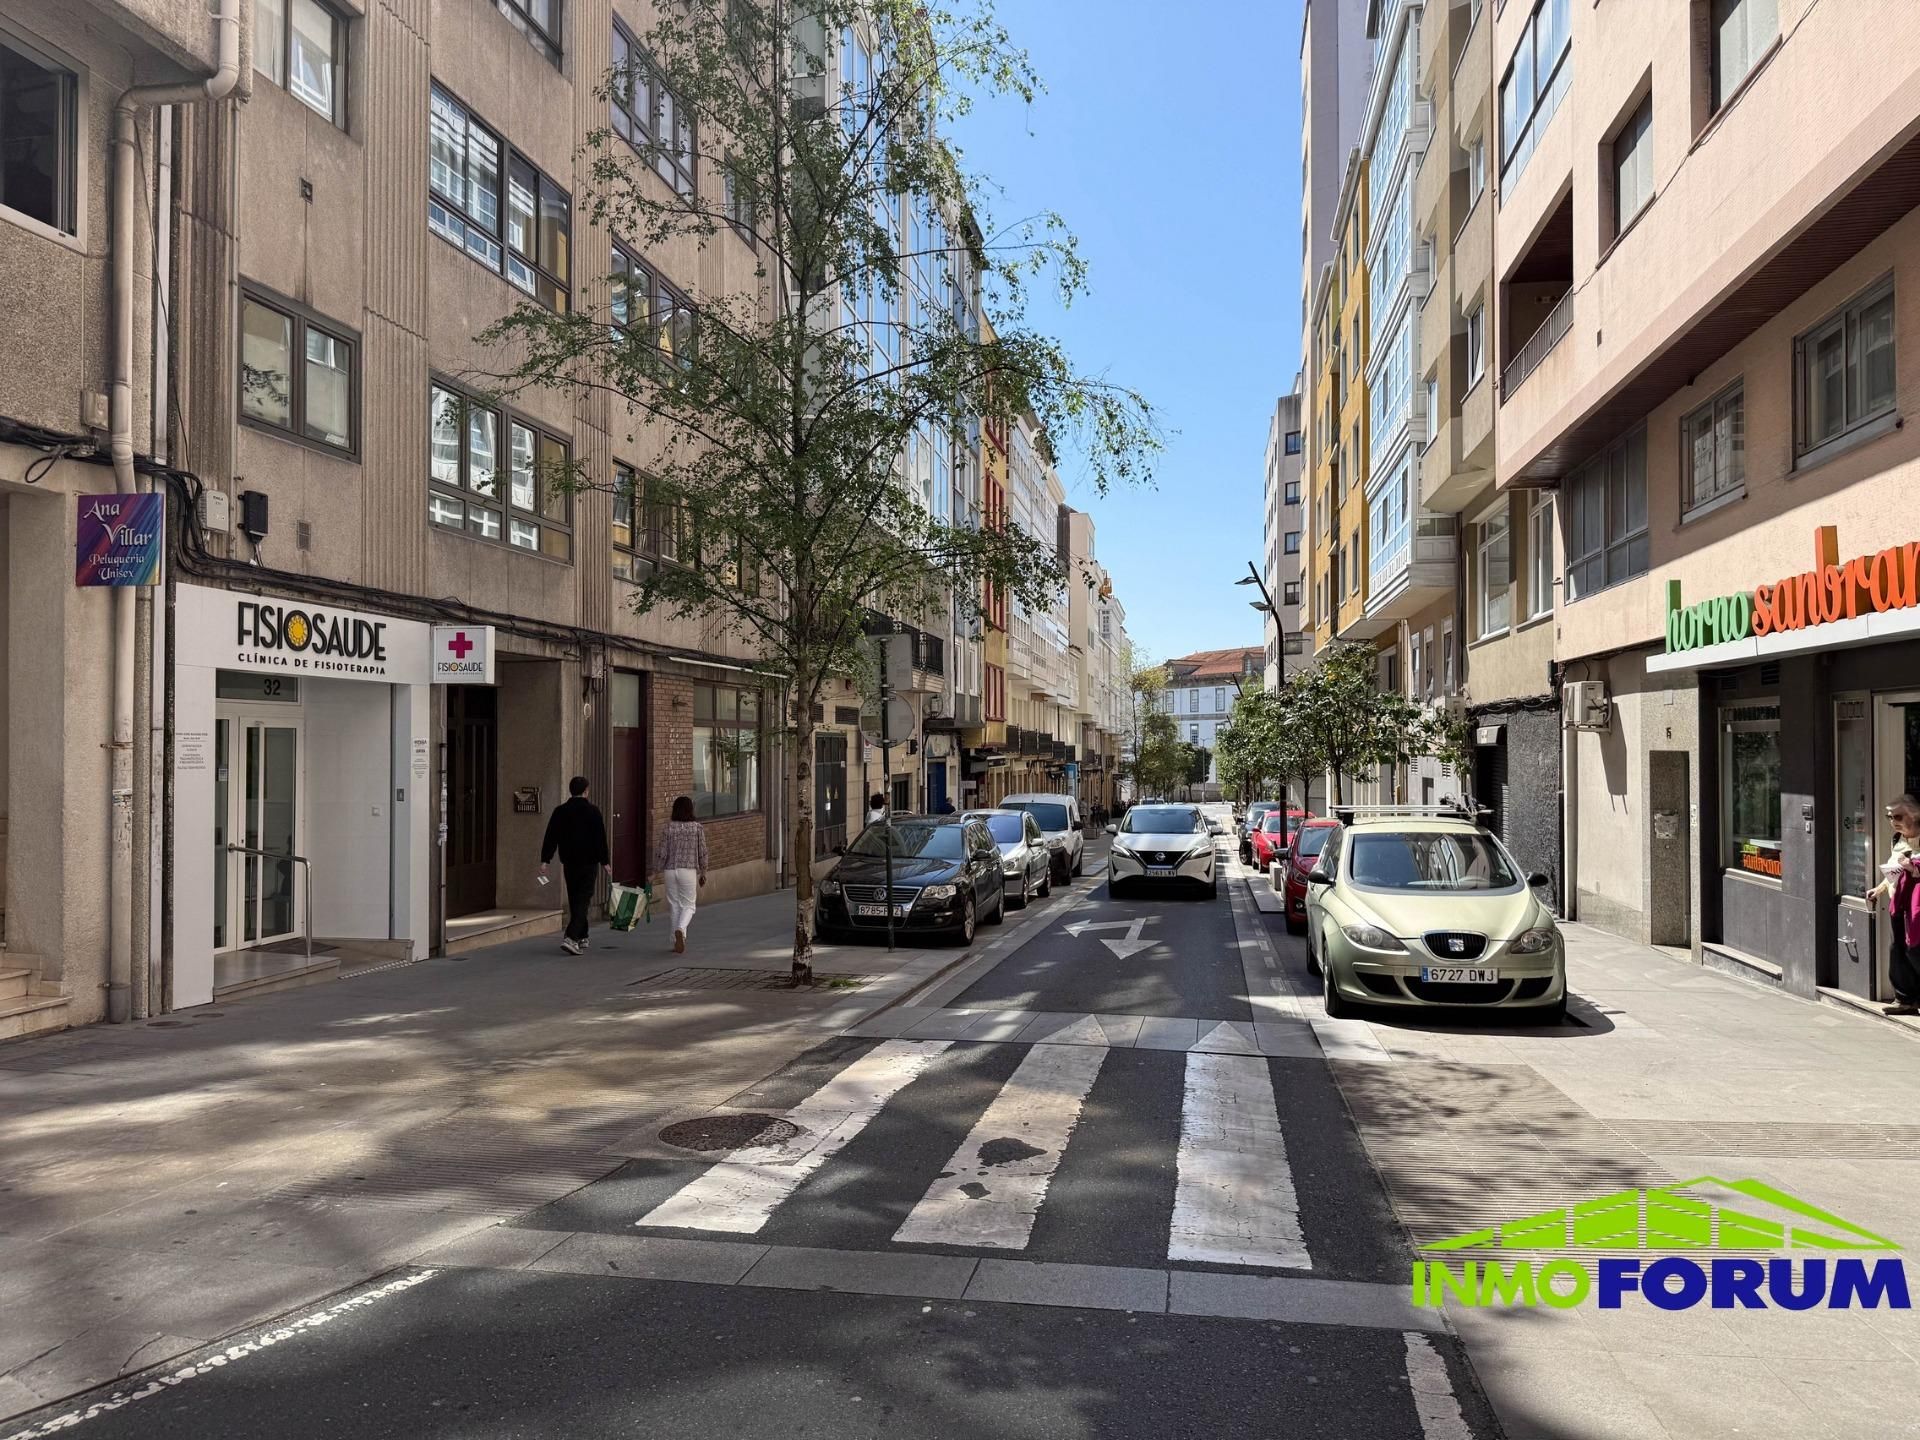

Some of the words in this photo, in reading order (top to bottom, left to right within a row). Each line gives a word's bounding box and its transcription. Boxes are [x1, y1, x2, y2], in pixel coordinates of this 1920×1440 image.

[83, 500, 120, 522] Ana
[101, 523, 152, 546] Villar
[98, 567, 135, 580] Unisex
[1665, 579, 1749, 655] horno
[238, 601, 387, 661] FISIOSAUDE
[238, 653, 288, 666] CLÍNICA
[294, 658, 308, 668] DE
[314, 660, 386, 675] FISIOTERAPIA
[437, 662, 483, 672] FISIOSAUDE
[263, 678, 281, 696] 32
[1431, 968, 1464, 981] 6727
[1469, 969, 1494, 982] DWJ
